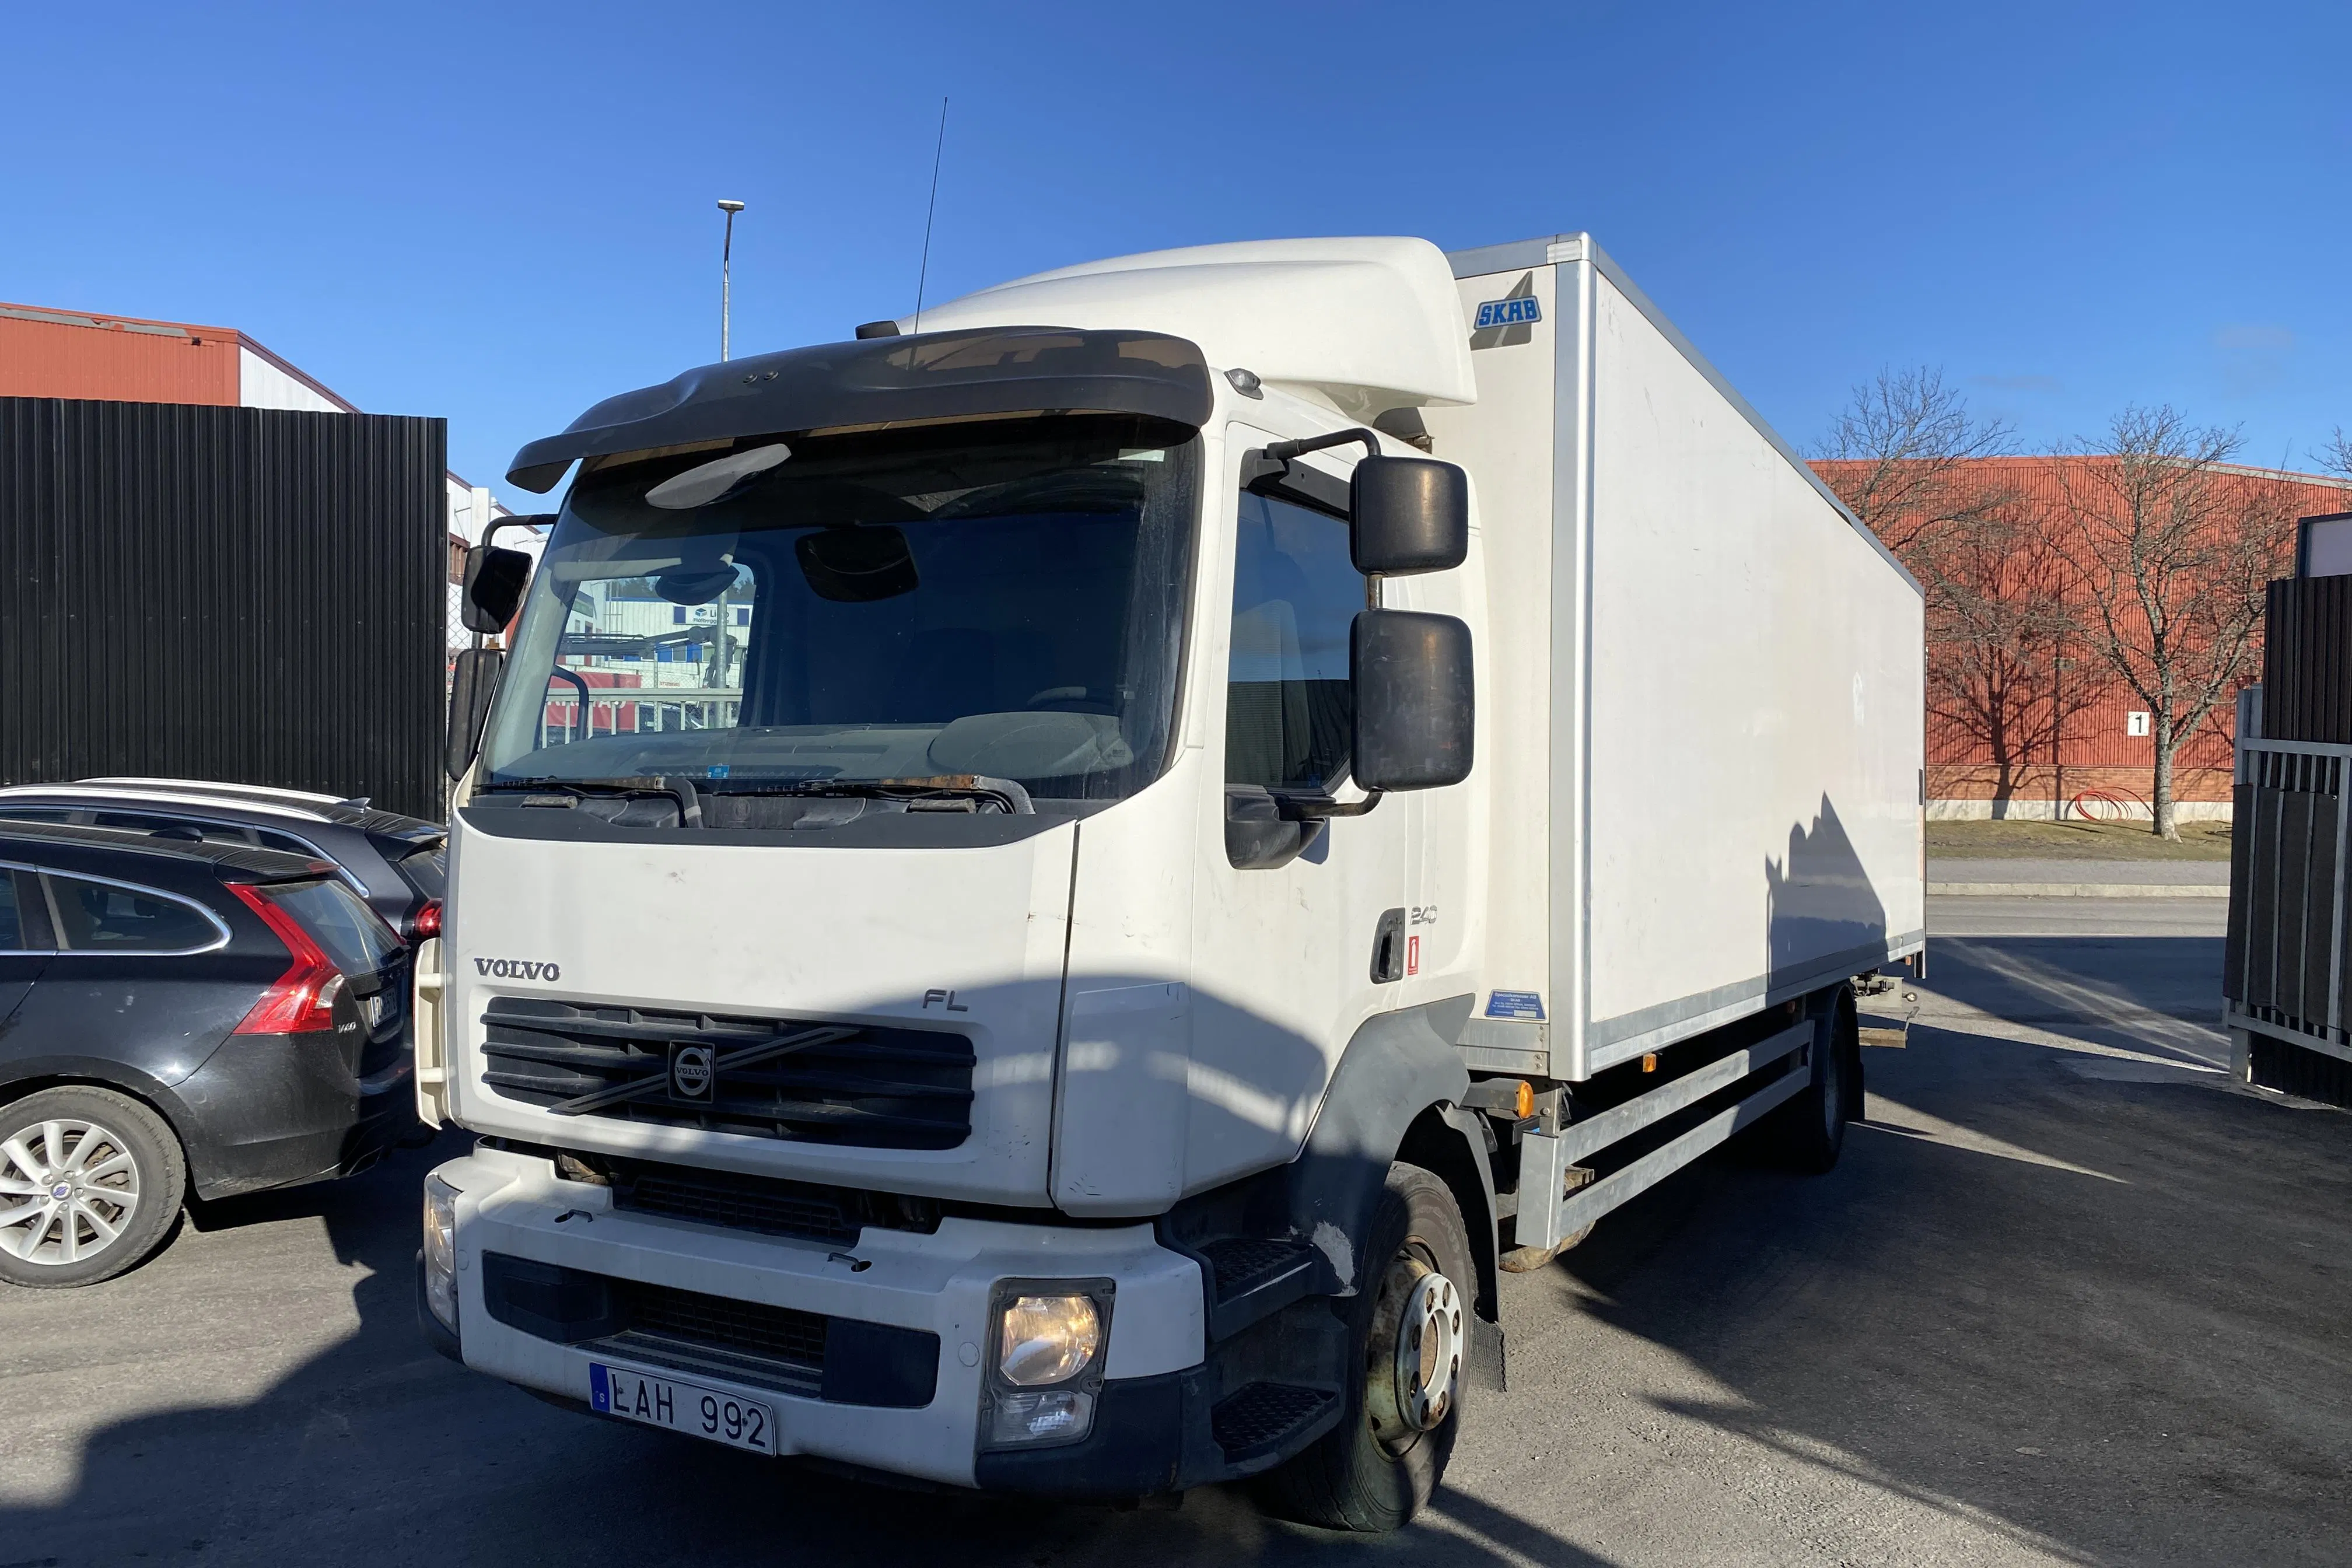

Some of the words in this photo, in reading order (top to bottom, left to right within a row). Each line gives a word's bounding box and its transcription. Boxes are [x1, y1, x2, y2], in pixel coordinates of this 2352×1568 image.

[1479, 300, 1537, 326] SKAB
[2135, 714, 2142, 733] 1
[1410, 905, 1437, 925] 240
[474, 957, 561, 982] VOLVO
[922, 989, 968, 1012] FL
[338, 1021, 356, 1034] V60
[676, 1067, 709, 1076] VOLVO
[598, 1392, 605, 1403] S
[612, 1374, 673, 1424] LAH
[701, 1395, 766, 1448] 992
